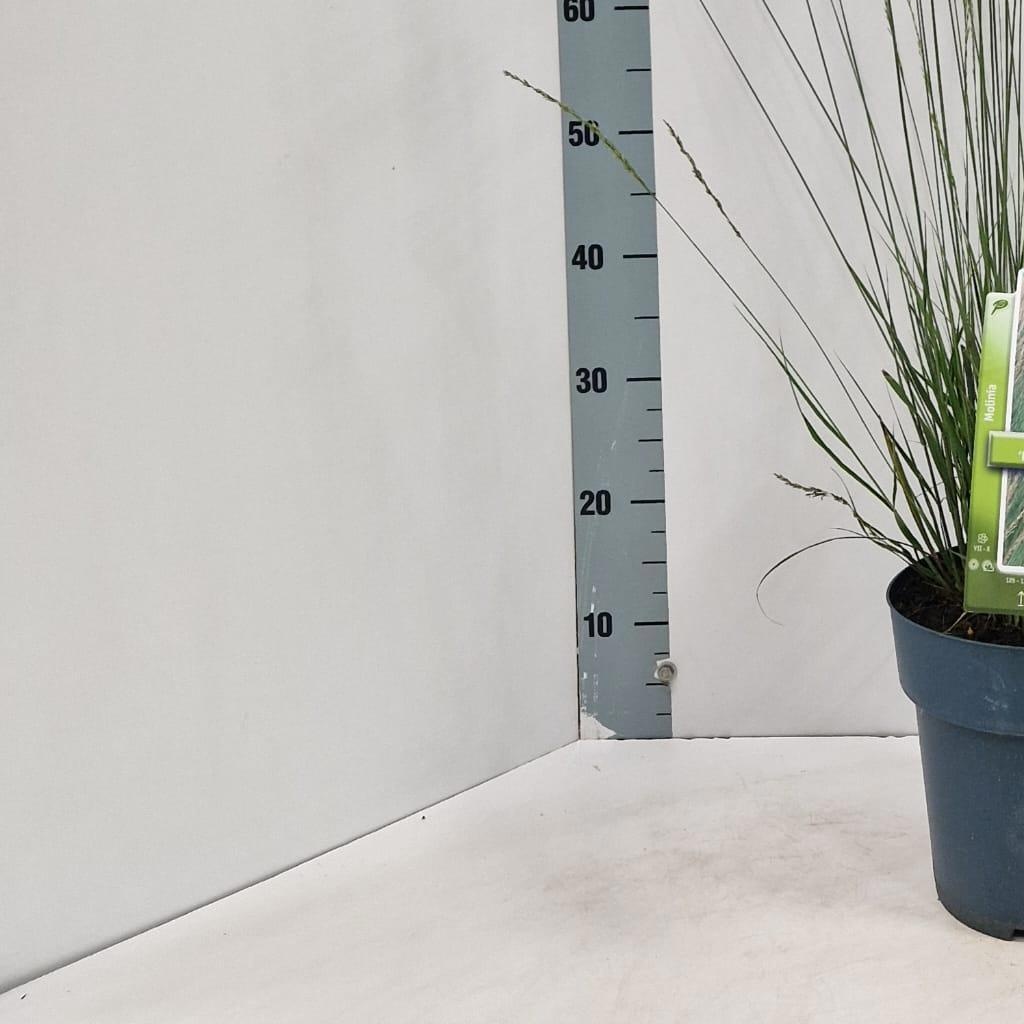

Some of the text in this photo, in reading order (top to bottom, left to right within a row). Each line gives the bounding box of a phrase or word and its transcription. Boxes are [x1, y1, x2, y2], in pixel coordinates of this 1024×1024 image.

[568, 120, 600, 147] 50
[572, 244, 604, 271] 40
[576, 367, 608, 394] 30
[984, 384, 997, 422] Molinia
[580, 489, 612, 516] 20
[583, 611, 613, 638] 10
